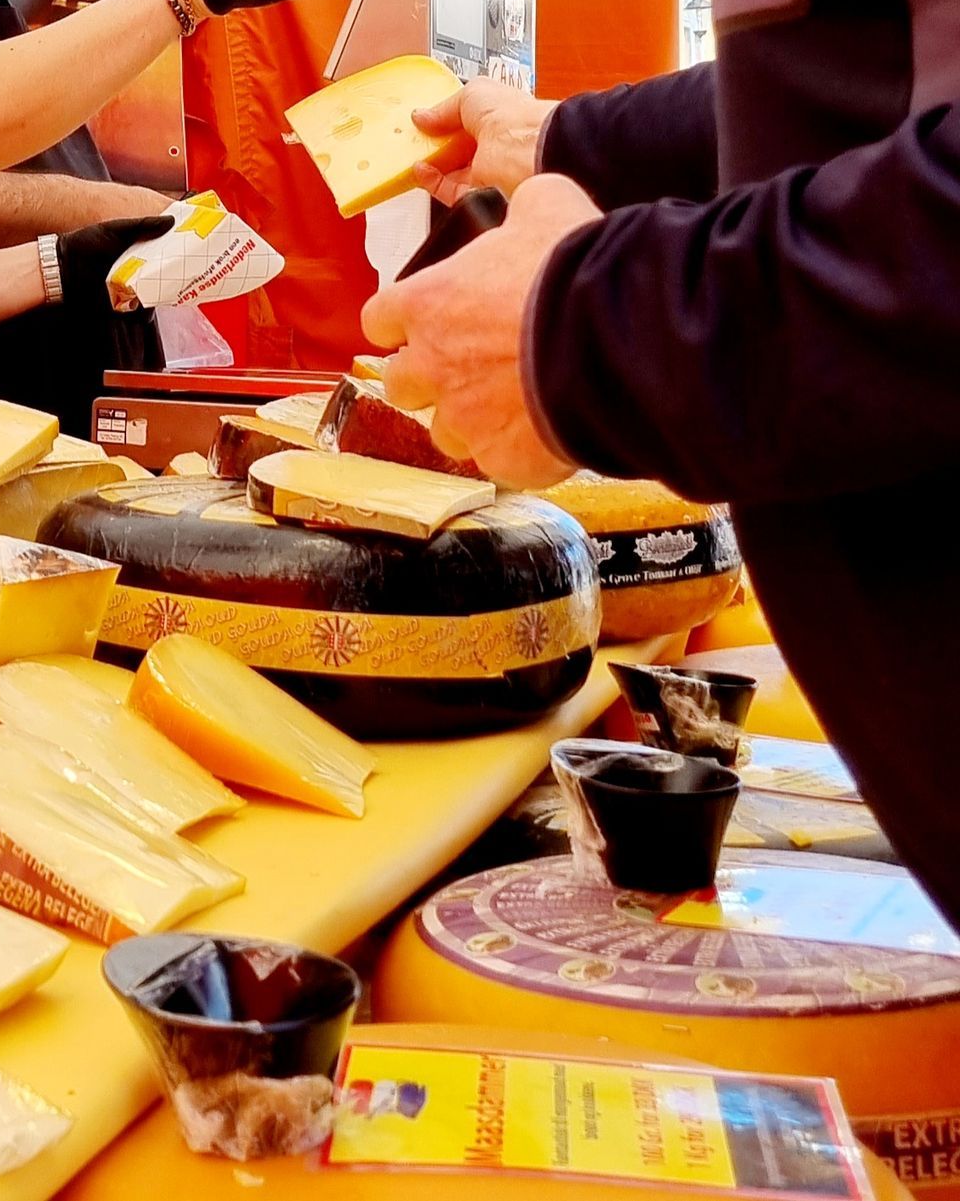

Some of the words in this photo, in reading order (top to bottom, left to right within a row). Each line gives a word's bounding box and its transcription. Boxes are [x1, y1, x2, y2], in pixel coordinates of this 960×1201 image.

[199, 238, 256, 291] Nederlandse
[893, 1117, 960, 1149] EXTR
[885, 1151, 960, 1181] ELEG
